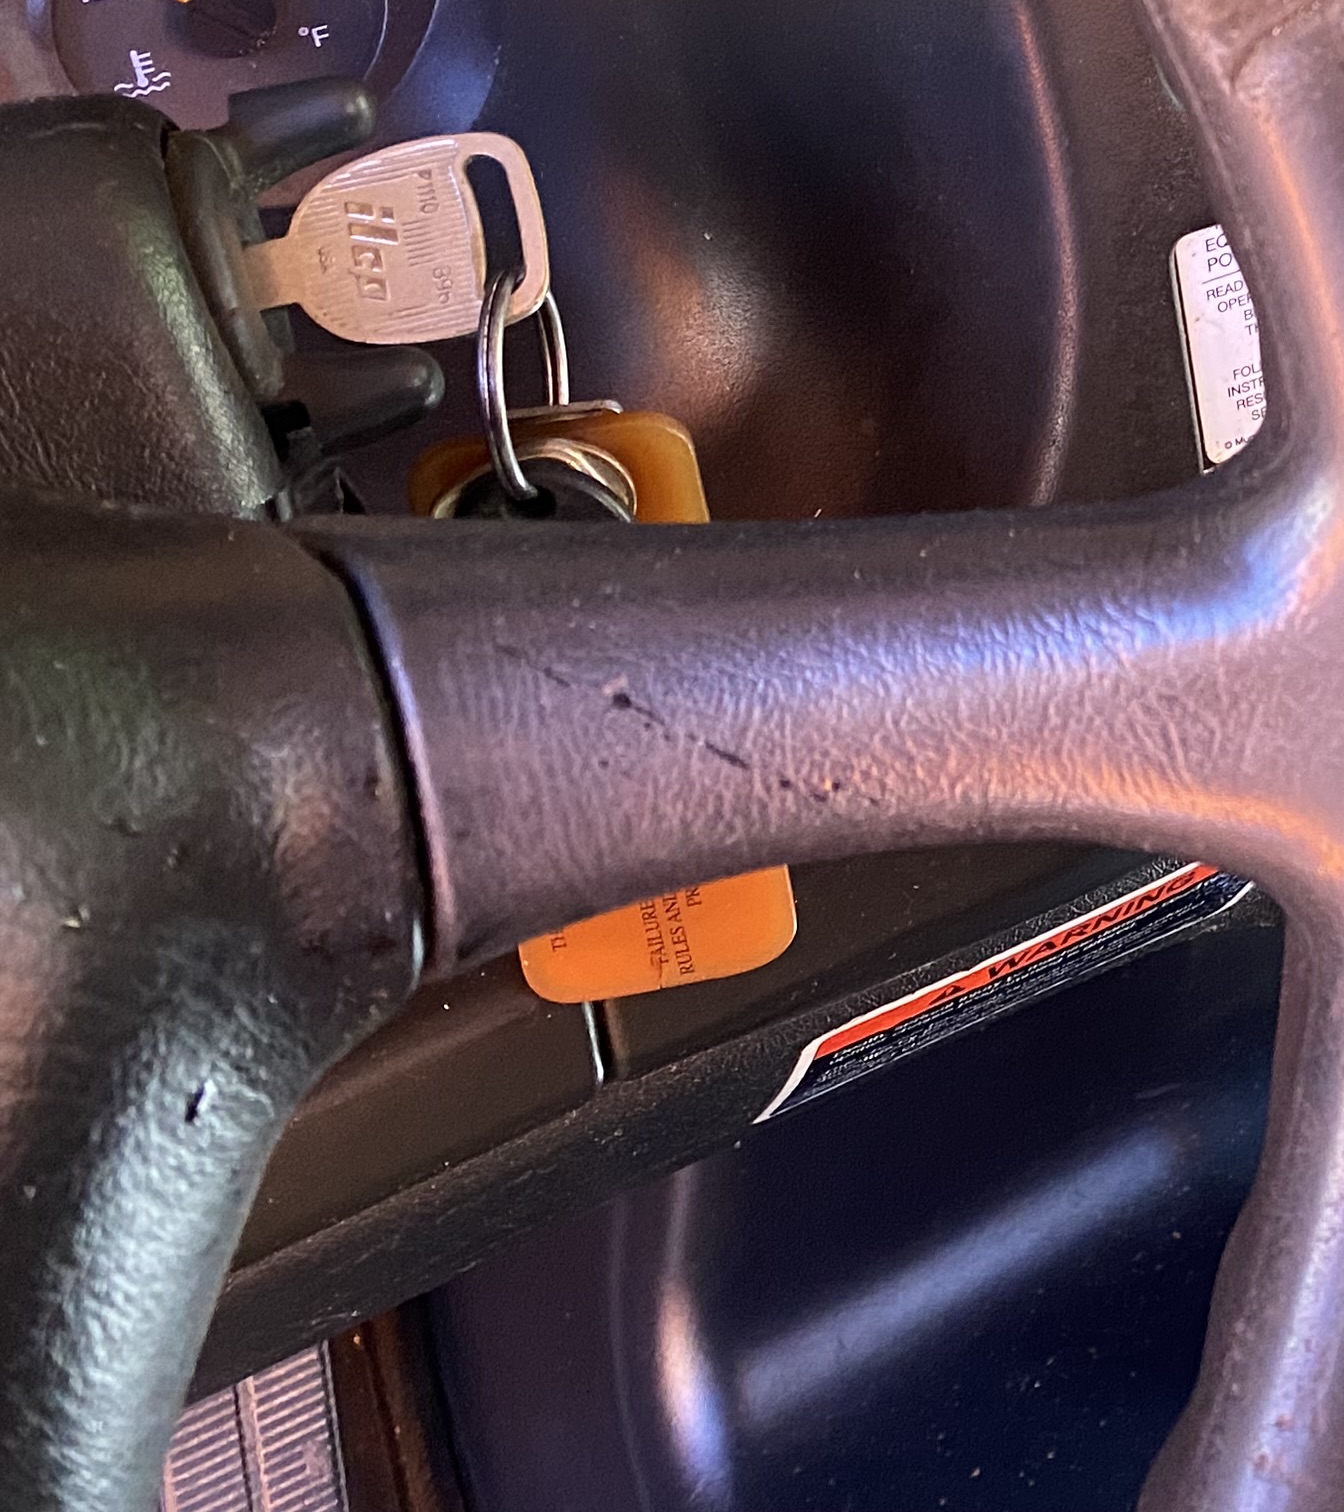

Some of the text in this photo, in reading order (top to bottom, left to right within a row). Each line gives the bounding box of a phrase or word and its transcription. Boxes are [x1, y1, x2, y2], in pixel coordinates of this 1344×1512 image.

[298, 24, 331, 48] °F
[1207, 252, 1232, 272] PO
[1206, 280, 1244, 301] READ
[1236, 392, 1264, 411] RES
[986, 870, 1198, 979] WARNING
[672, 926, 695, 976] RULES
